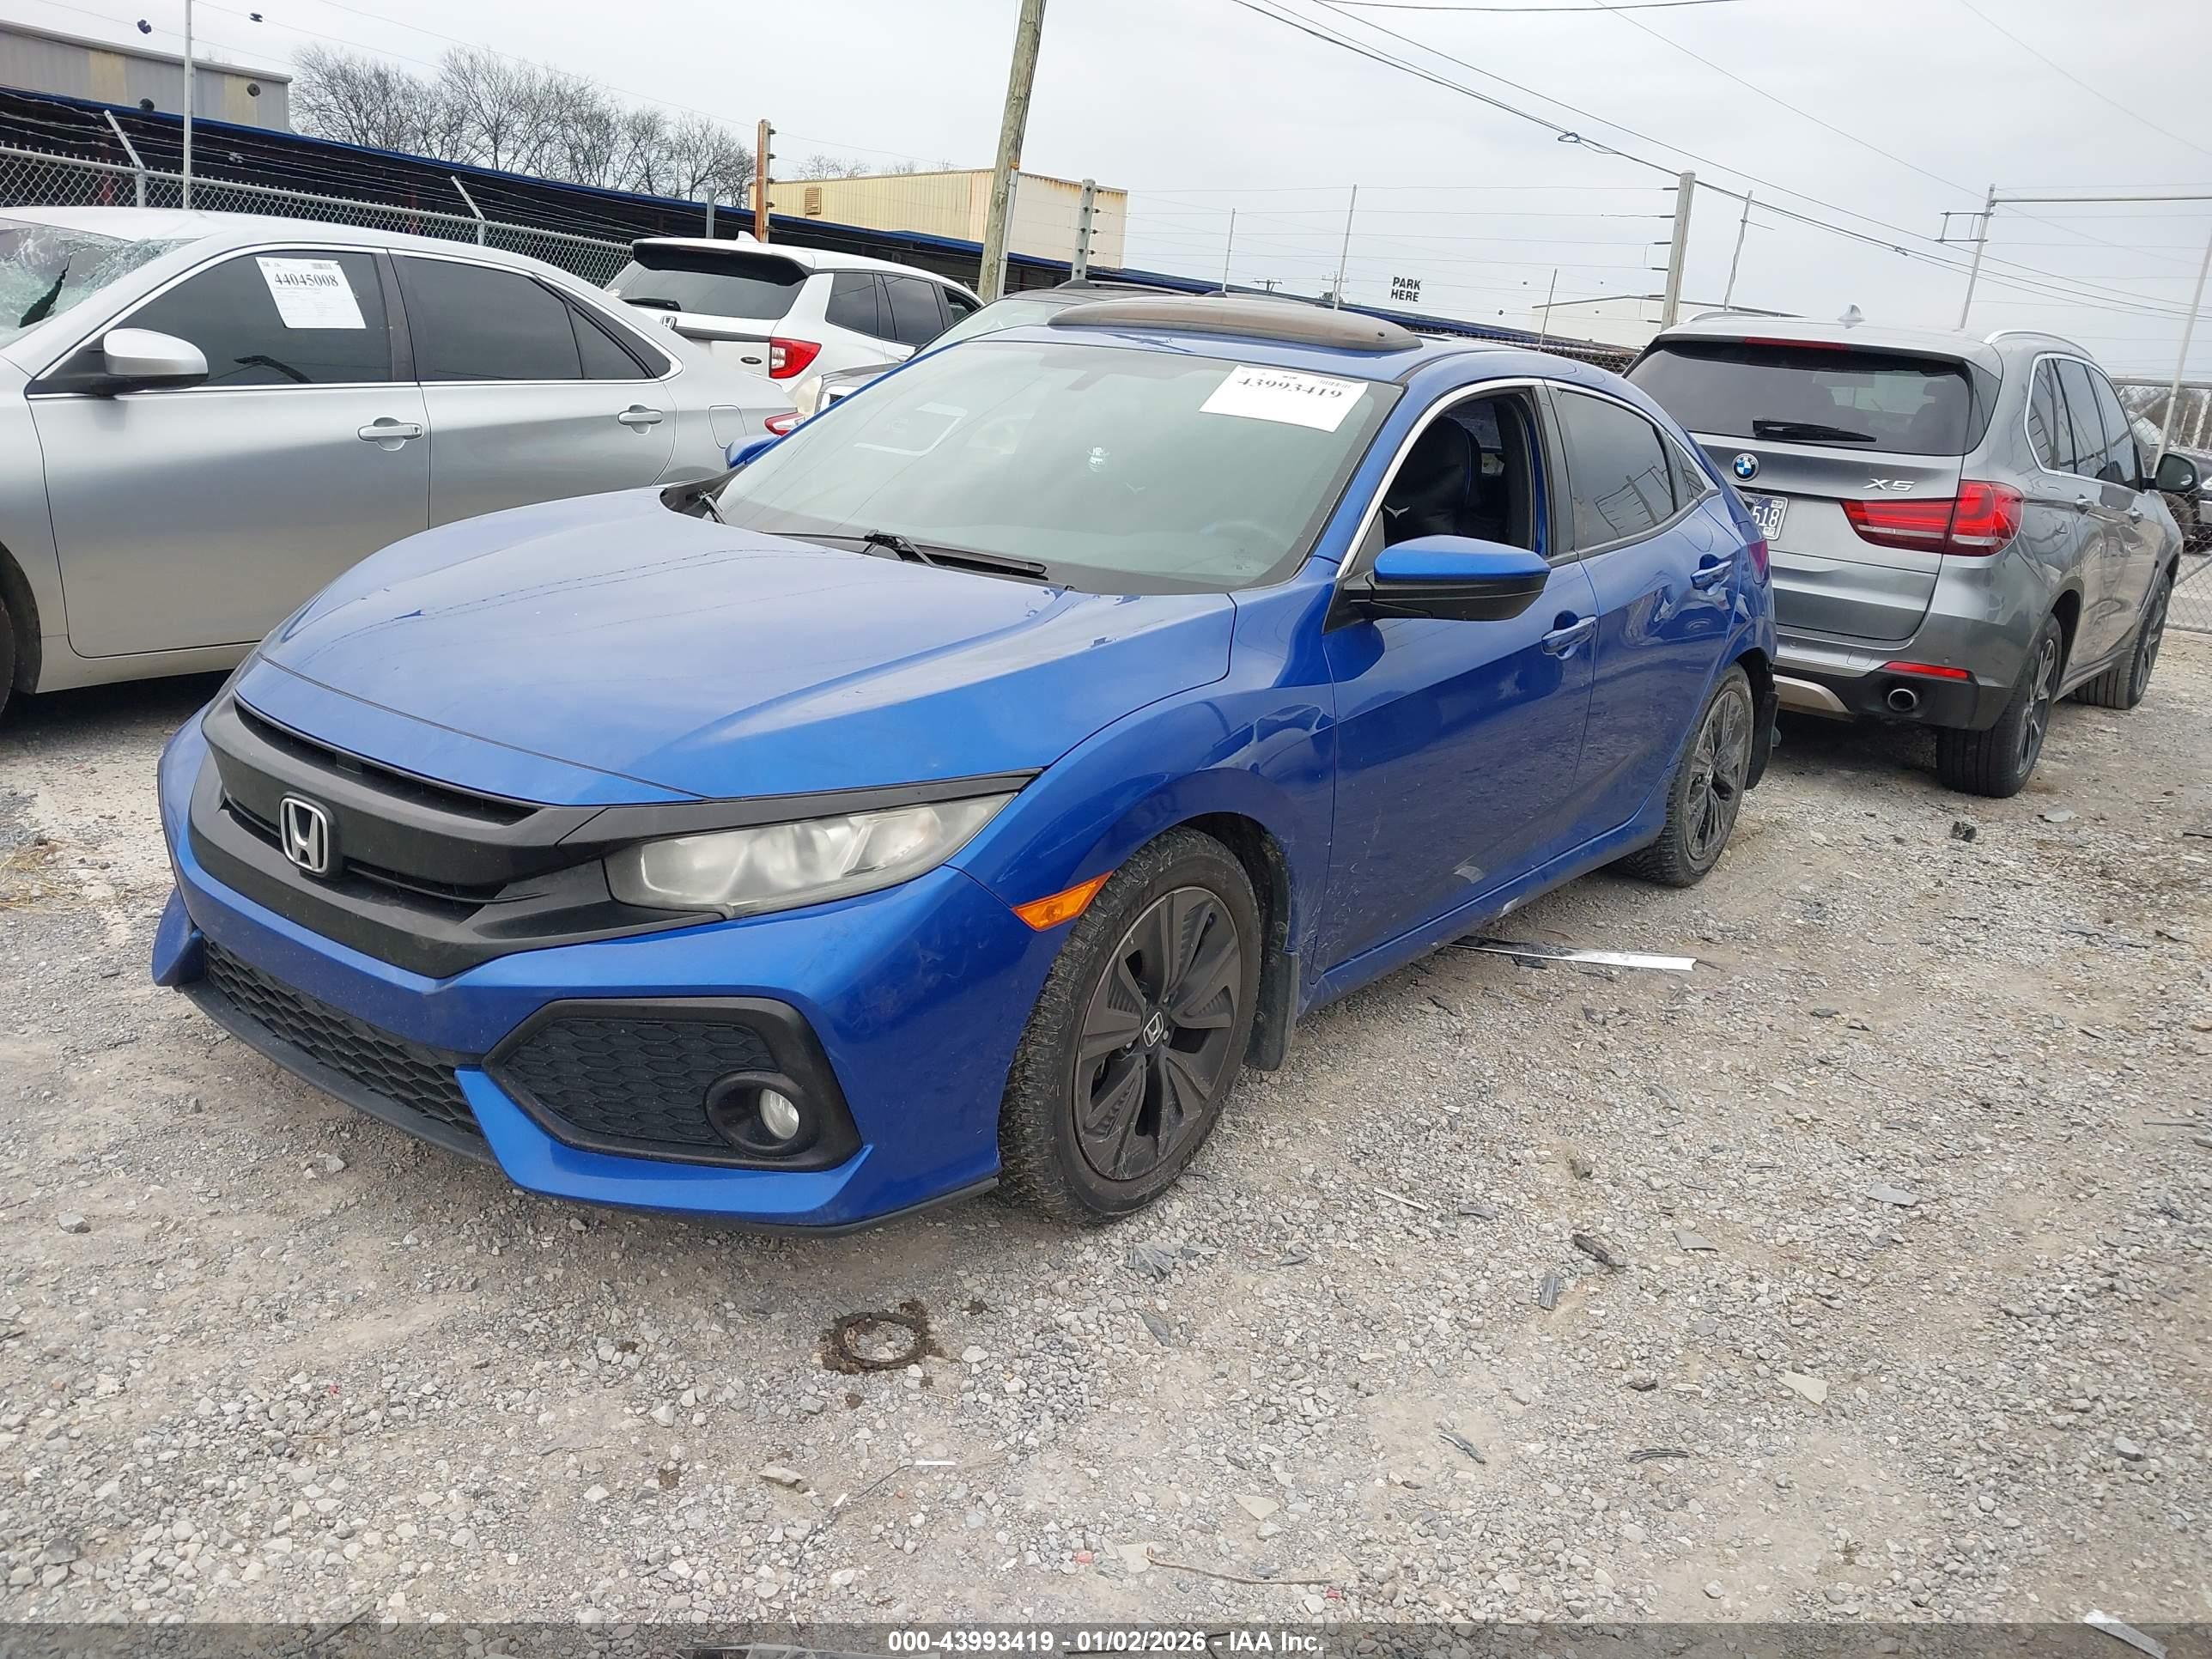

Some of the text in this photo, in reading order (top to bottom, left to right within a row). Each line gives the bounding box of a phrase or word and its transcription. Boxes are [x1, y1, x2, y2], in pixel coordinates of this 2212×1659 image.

[274, 273, 339, 287] 44045008
[1392, 276, 1421, 291] PARK
[1390, 289, 1419, 302] HERE
[1237, 377, 1342, 398] 43993419
[1862, 477, 1917, 492] X5
